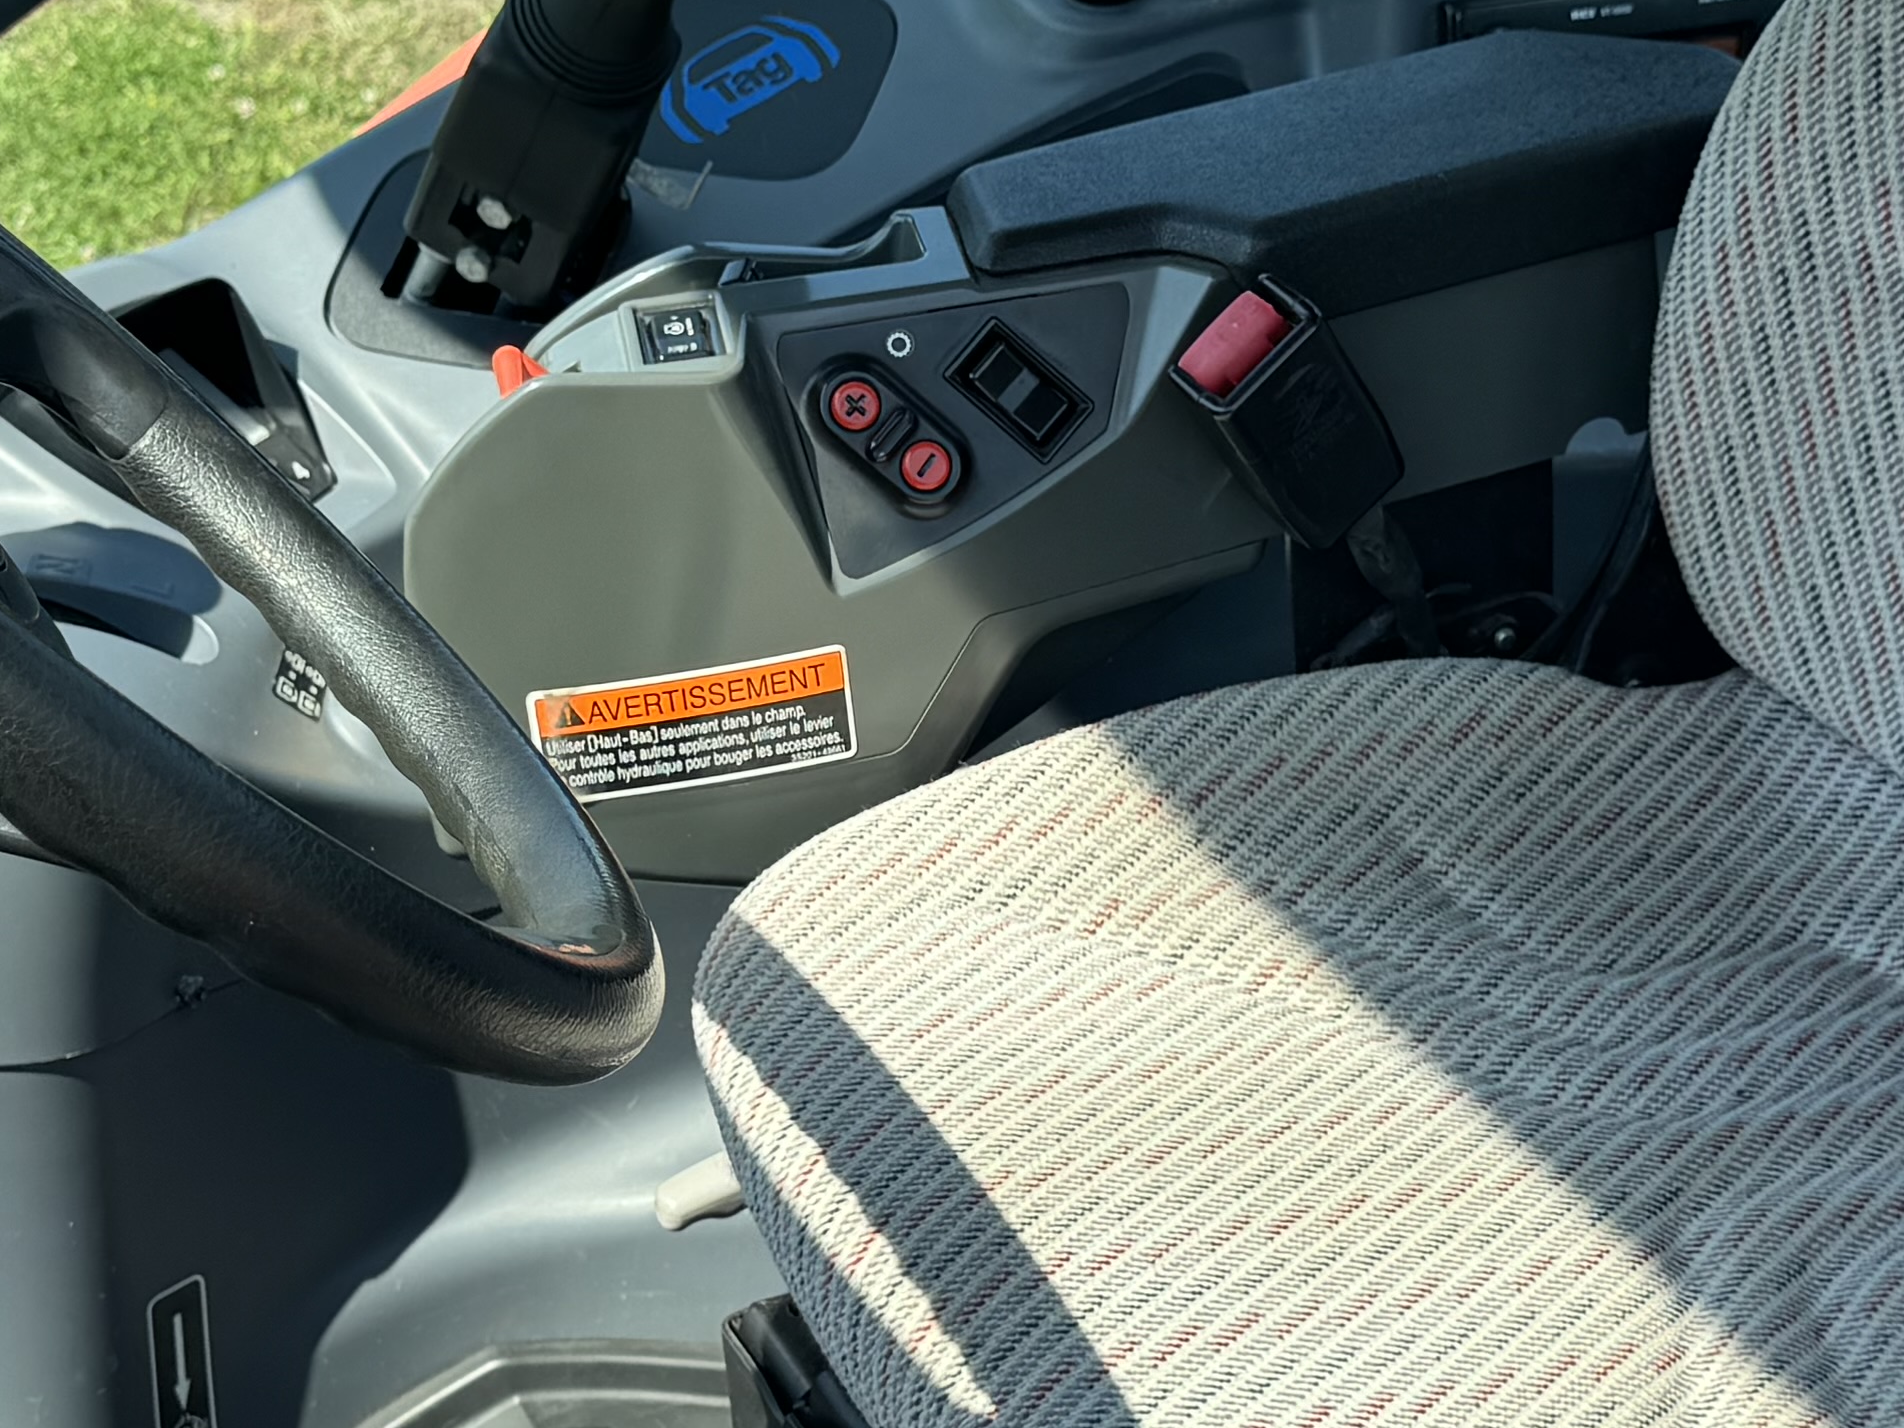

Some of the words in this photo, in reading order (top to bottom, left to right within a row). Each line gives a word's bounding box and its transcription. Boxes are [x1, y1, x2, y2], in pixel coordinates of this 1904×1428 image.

[588, 662, 826, 724] AVERTISSEMENT
[545, 740, 586, 757] Utiliser
[659, 718, 720, 741] seulement
[721, 714, 750, 731] dans
[751, 710, 763, 726] le
[548, 755, 577, 772] Pour
[579, 752, 616, 769] toutes
[618, 748, 637, 764] les
[639, 743, 676, 761] autres
[678, 730, 750, 760] applications,
[749, 724, 787, 743] utiliser
[789, 720, 801, 735] le
[803, 714, 834, 732] levier
[616, 758, 684, 785] hydraulique
[684, 754, 712, 773] pour
[713, 748, 753, 767] bouger
[755, 742, 773, 759] les
[775, 730, 844, 756] accessoires.
